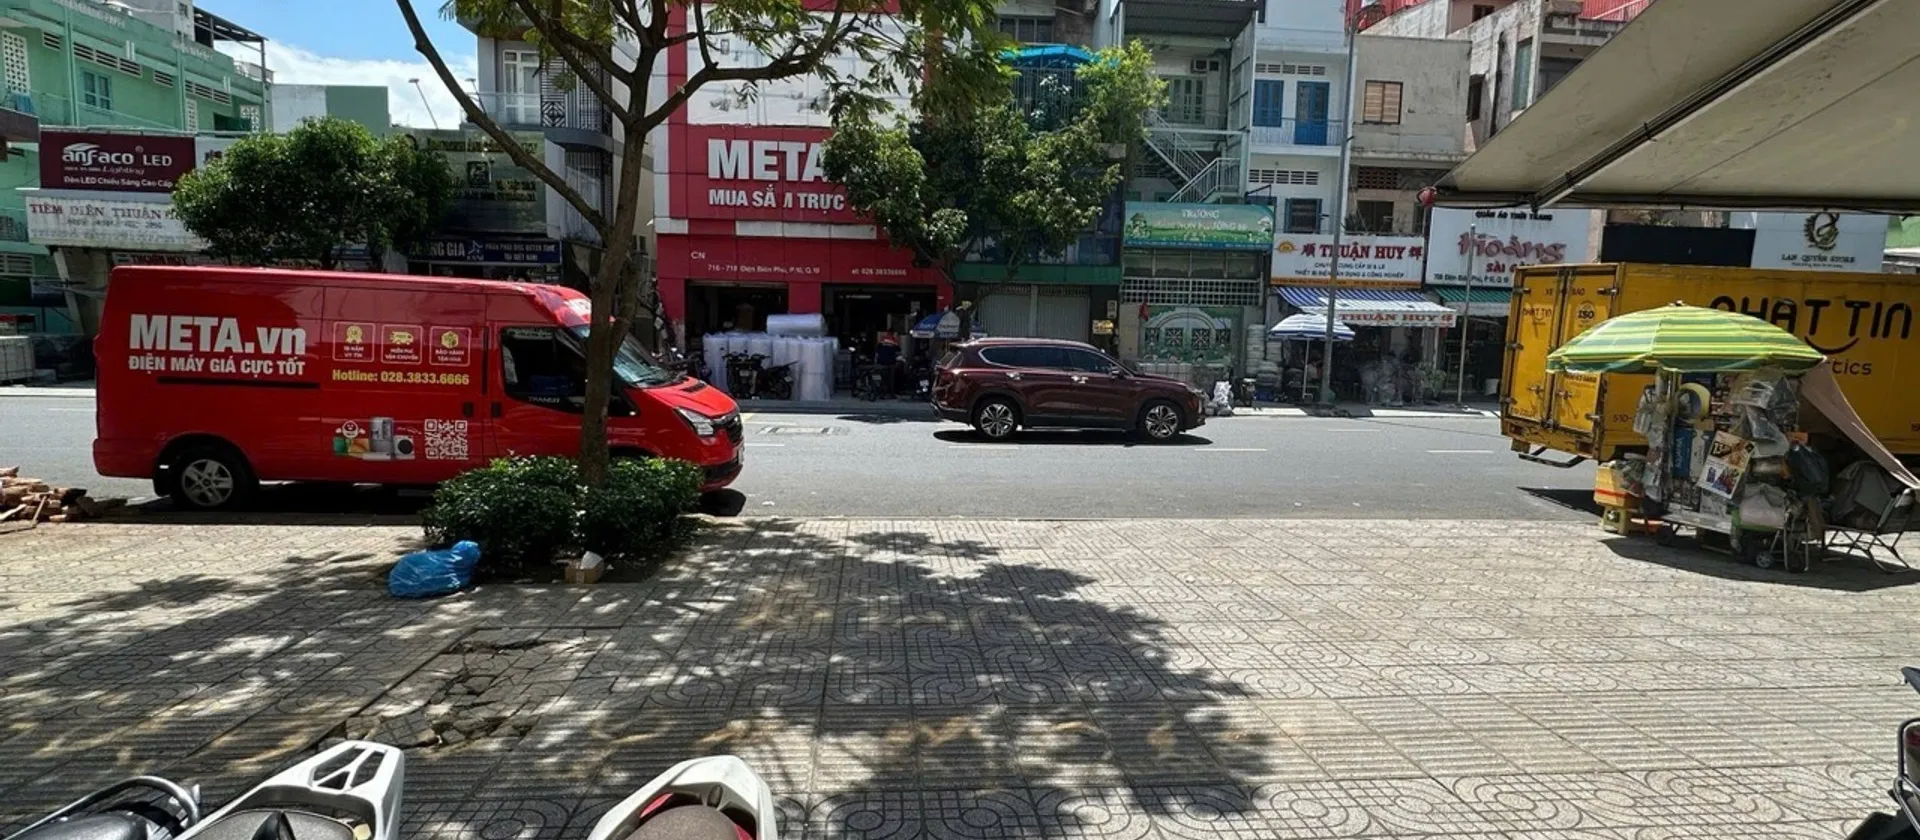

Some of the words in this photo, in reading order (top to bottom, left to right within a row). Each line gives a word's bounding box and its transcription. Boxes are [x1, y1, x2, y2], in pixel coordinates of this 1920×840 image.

[62, 149, 134, 166] anfaco
[142, 154, 172, 167] LED
[80, 176, 96, 185] LED
[708, 188, 748, 206] MUA
[797, 191, 845, 214] TRỰC
[690, 251, 706, 259] CN
[1374, 246, 1406, 260] HUY
[1578, 310, 1595, 319] ISO
[129, 313, 307, 356] META.vn
[128, 352, 165, 375] ĐIỆN
[170, 354, 204, 373] MÁY
[209, 355, 236, 373] GIÁ
[240, 359, 273, 378] CỰC
[276, 356, 306, 375] TỐT
[332, 369, 378, 382] Hotline:
[380, 370, 470, 385] 028.3833.6666
